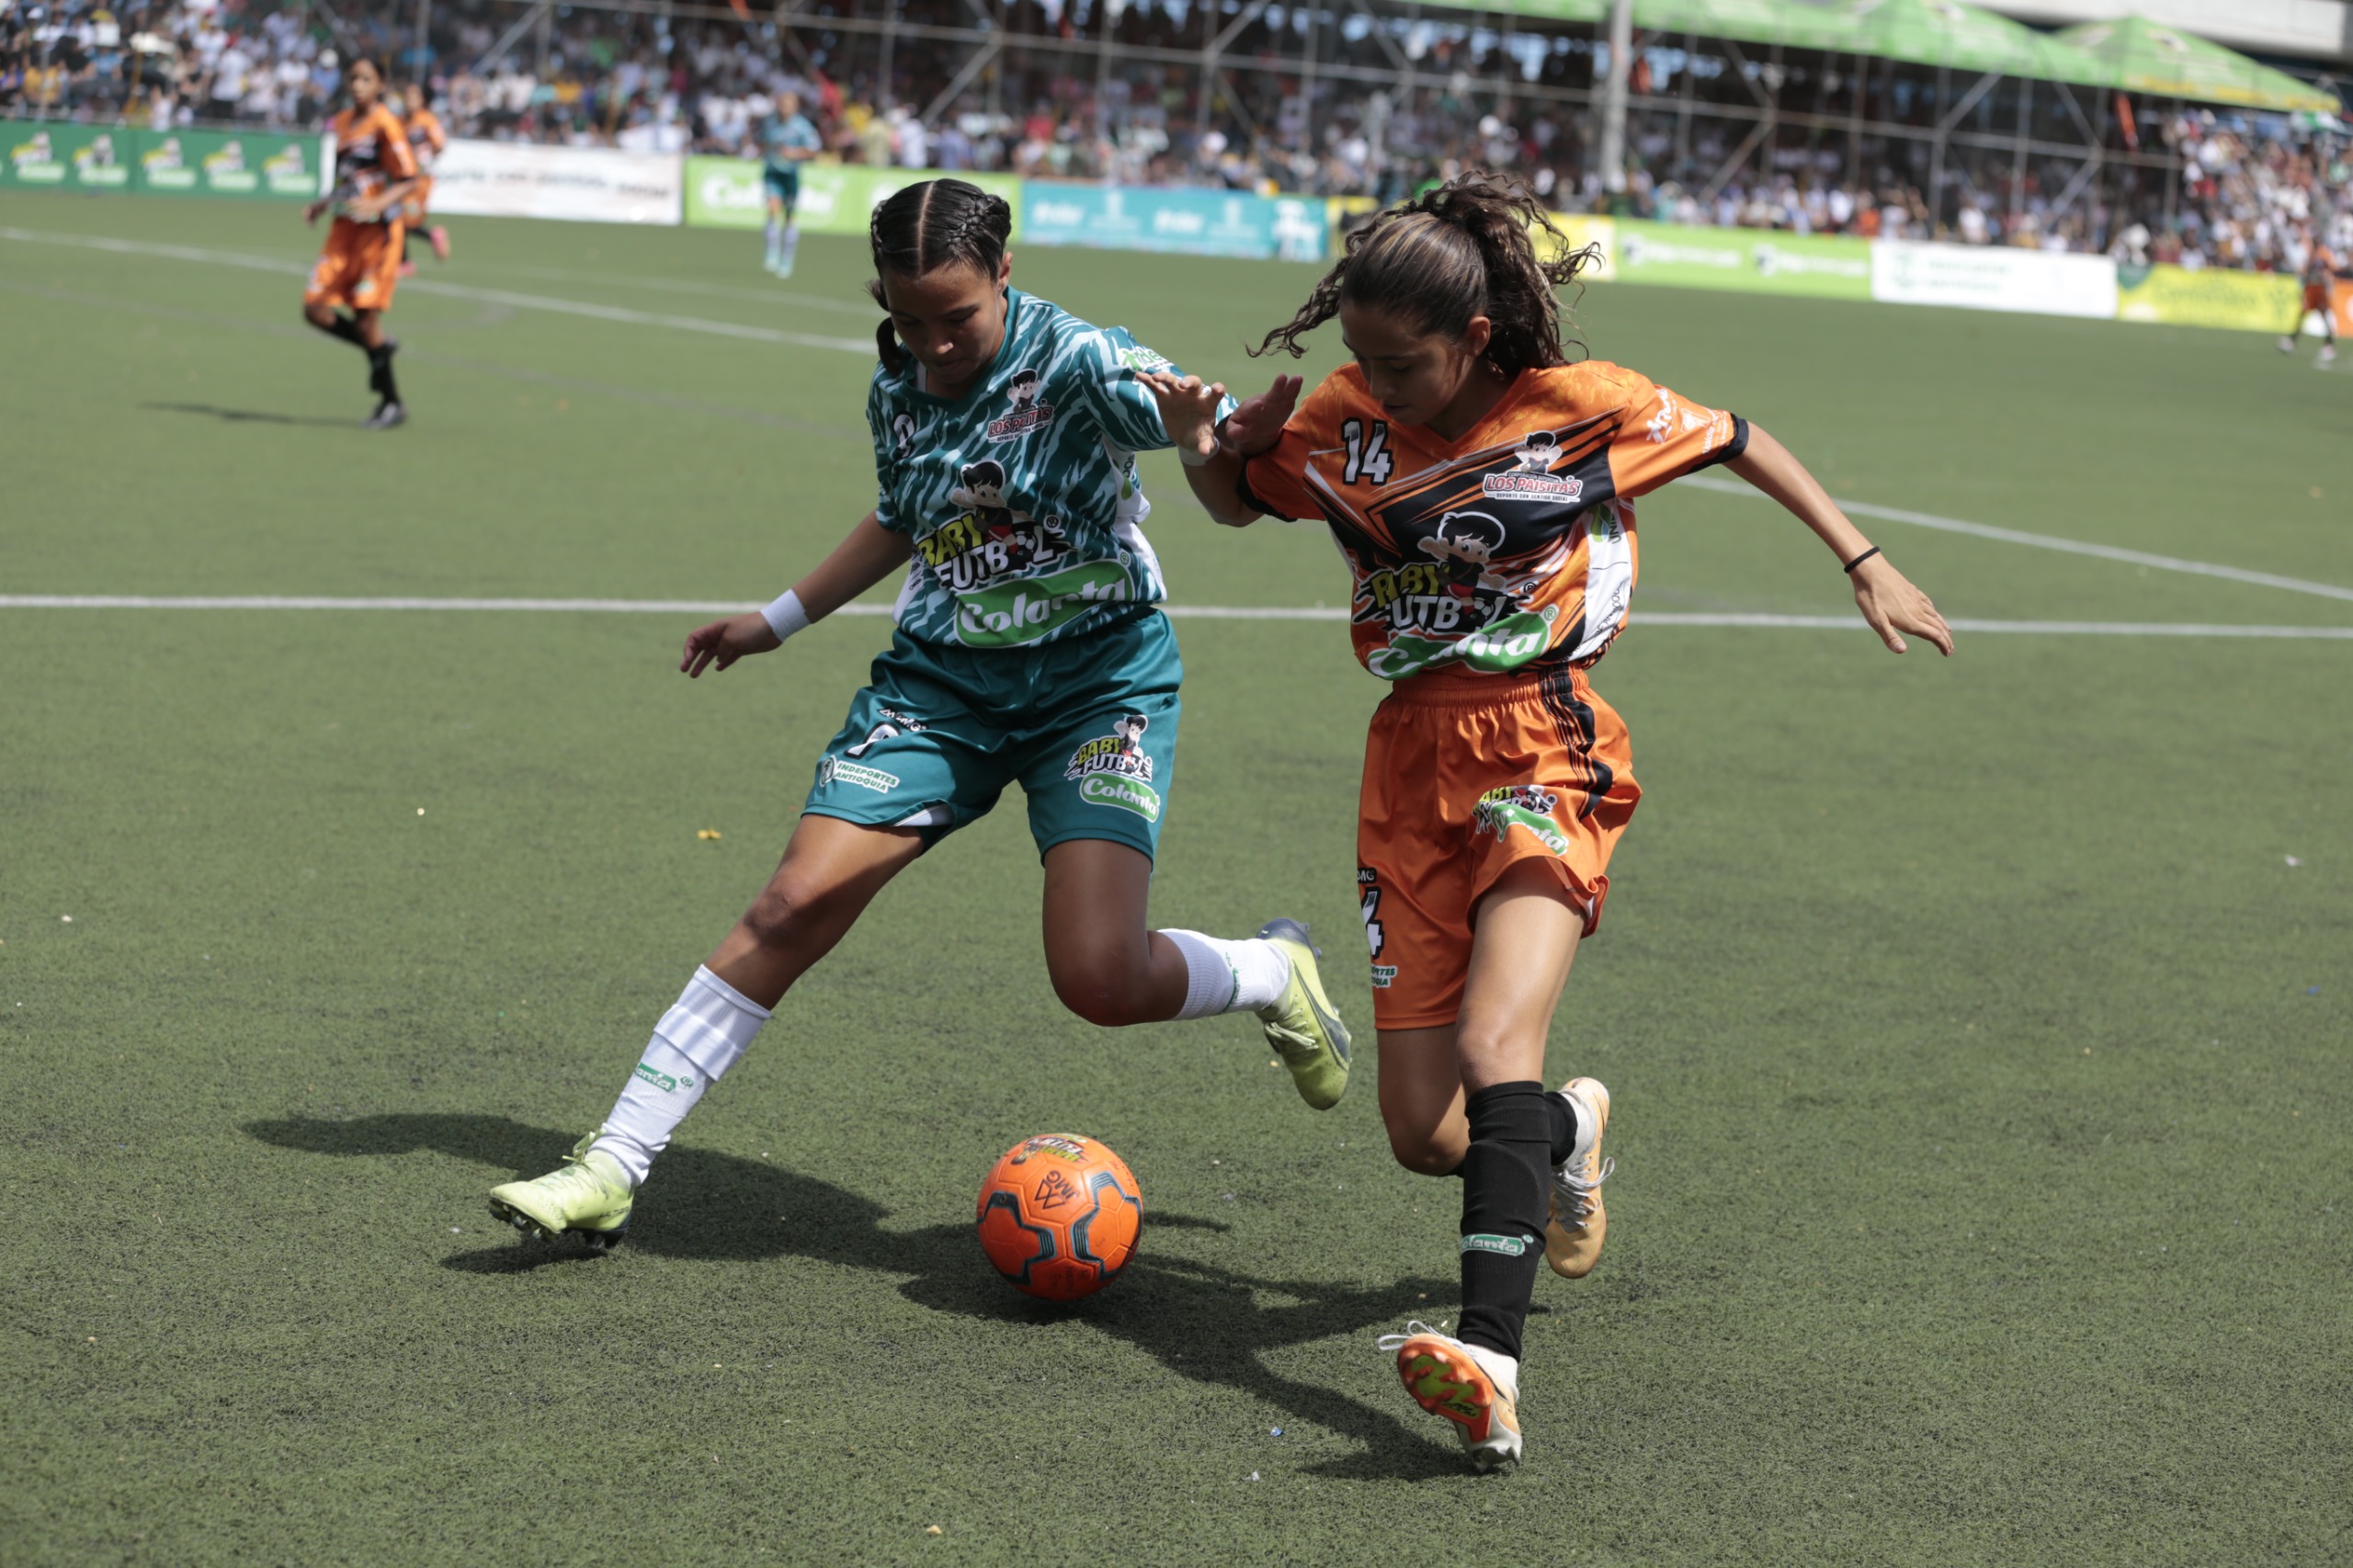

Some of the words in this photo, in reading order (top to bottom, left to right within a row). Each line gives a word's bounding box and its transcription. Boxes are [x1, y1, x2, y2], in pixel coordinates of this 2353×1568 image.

[989, 418, 1010, 437] LOS
[1344, 420, 1392, 483] 14
[1486, 476, 1515, 492] LOS
[1516, 477, 1580, 495] PAISITAS
[1077, 737, 1125, 766] BABY
[833, 771, 887, 791] ANTIOQUIA
[836, 762, 898, 787] INDEPORTES
[1085, 778, 1157, 816] Colanta
[1046, 1169, 1079, 1200] JMG
[1461, 1234, 1518, 1254] olanta
